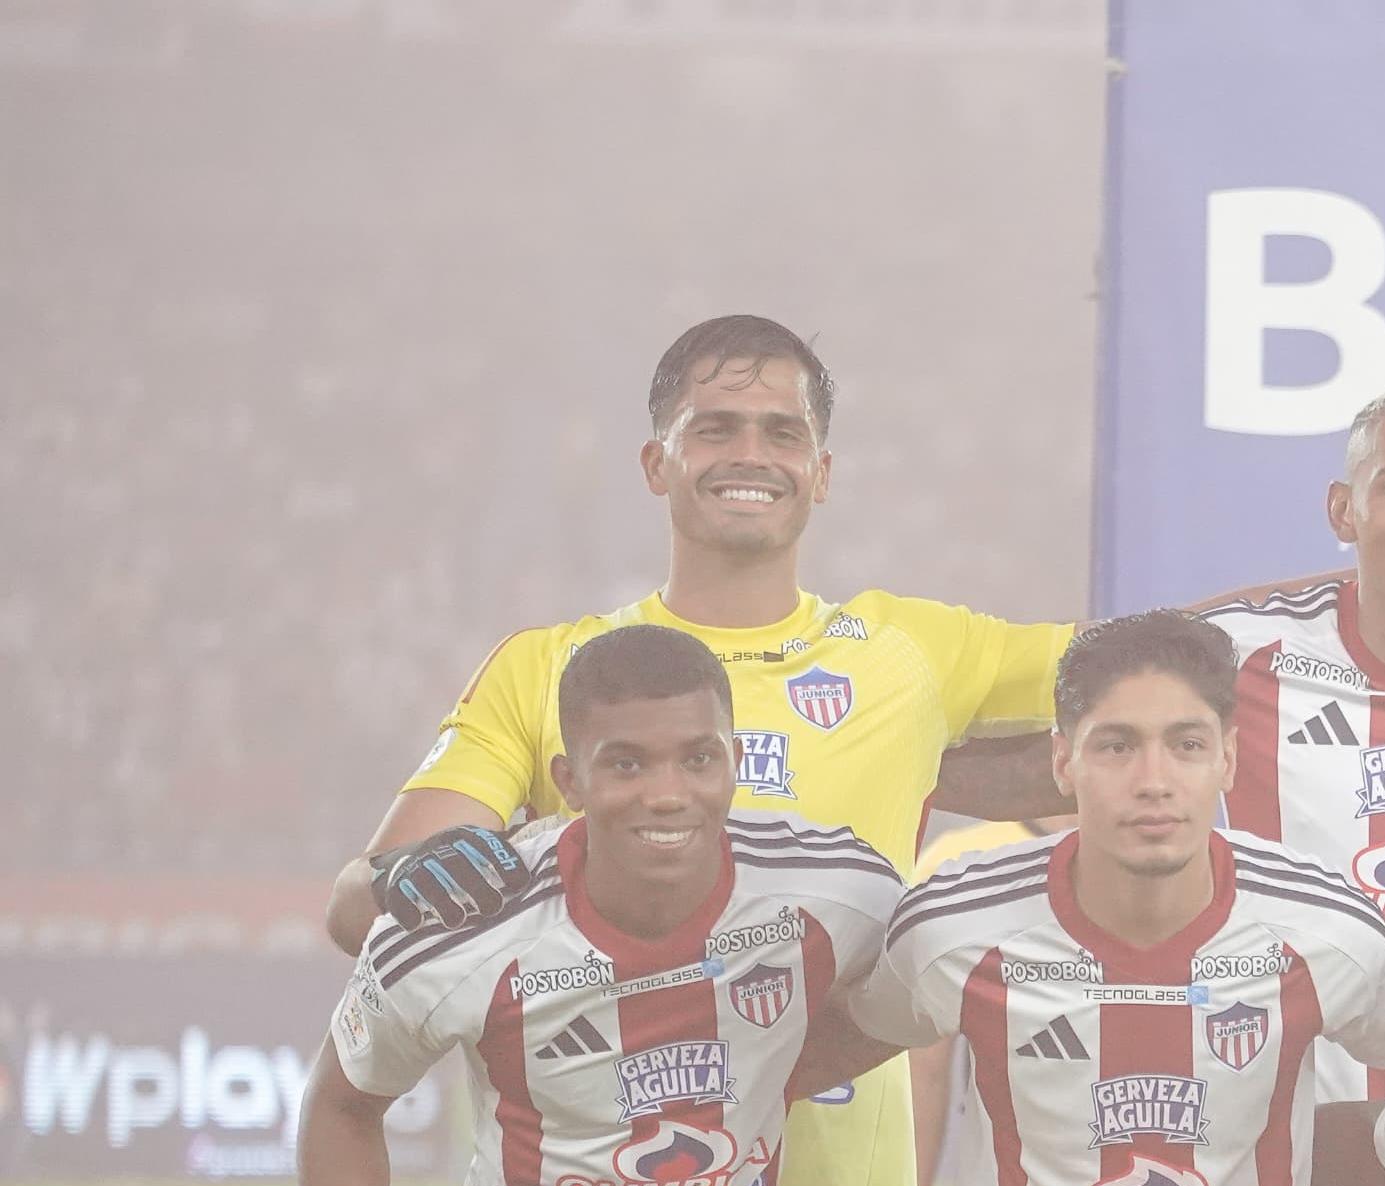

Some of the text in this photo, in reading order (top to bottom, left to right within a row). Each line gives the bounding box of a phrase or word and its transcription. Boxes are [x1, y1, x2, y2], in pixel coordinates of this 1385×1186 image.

[799, 688, 844, 699] JUNIOR
[739, 980, 786, 1000] JUNIOR
[1215, 1021, 1261, 1038] JUNIOR
[627, 1066, 720, 1105] AGUILA
[1104, 1101, 1193, 1136] AGUILA
